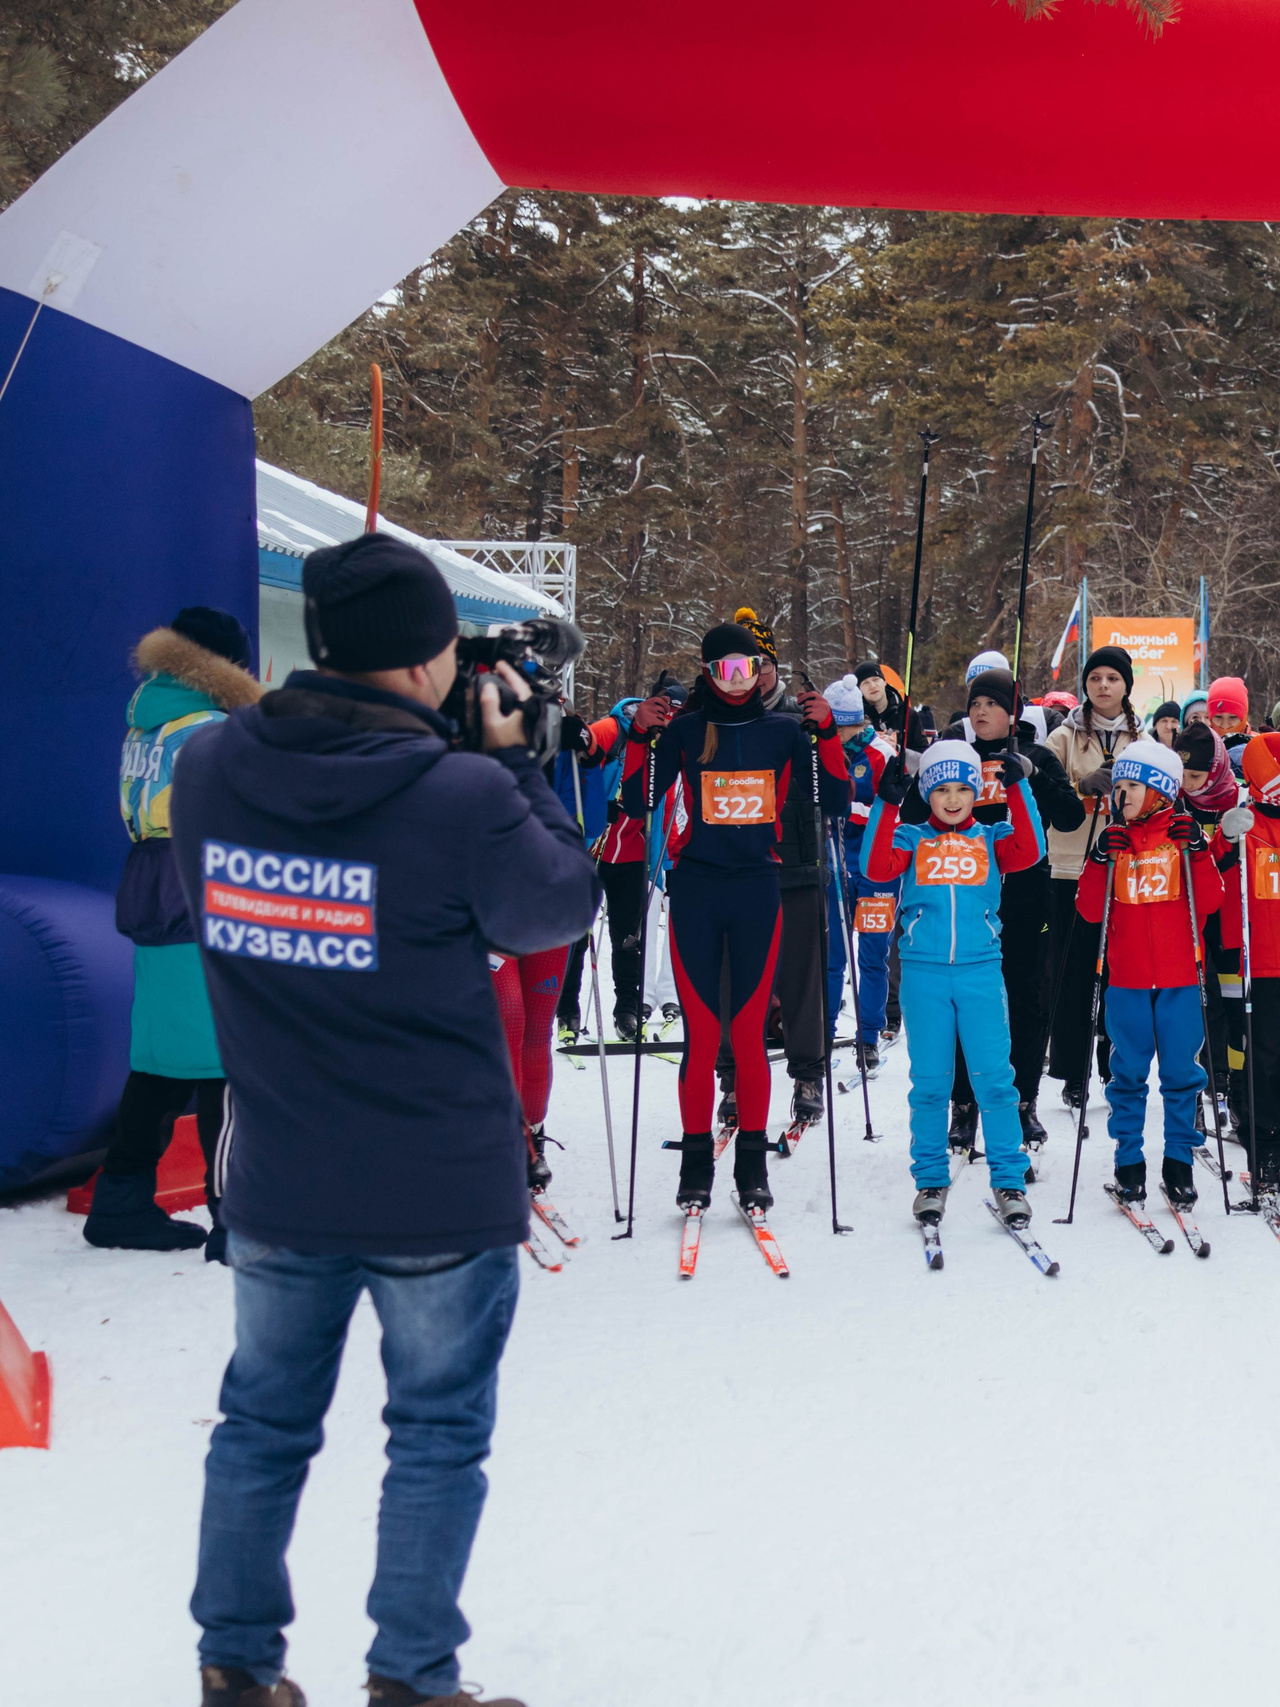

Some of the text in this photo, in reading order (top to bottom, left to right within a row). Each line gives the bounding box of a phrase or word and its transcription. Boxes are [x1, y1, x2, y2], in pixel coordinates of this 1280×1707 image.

[1108, 632, 1178, 646] Лыжный
[1127, 646, 1165, 660] абег
[1113, 768, 1141, 780] ССИИ
[1115, 761, 1142, 772] ЖНЯ
[728, 777, 764, 786] Goodline
[713, 796, 764, 819] 322
[205, 844, 373, 902] РОССИЯ
[926, 856, 977, 879] 259
[1127, 874, 1168, 900] 142
[211, 889, 365, 927] ТЕЛЕВИДЕНИЕ И РАДИО
[862, 914, 887, 929] 153
[206, 917, 374, 969] КУЗБАСС
